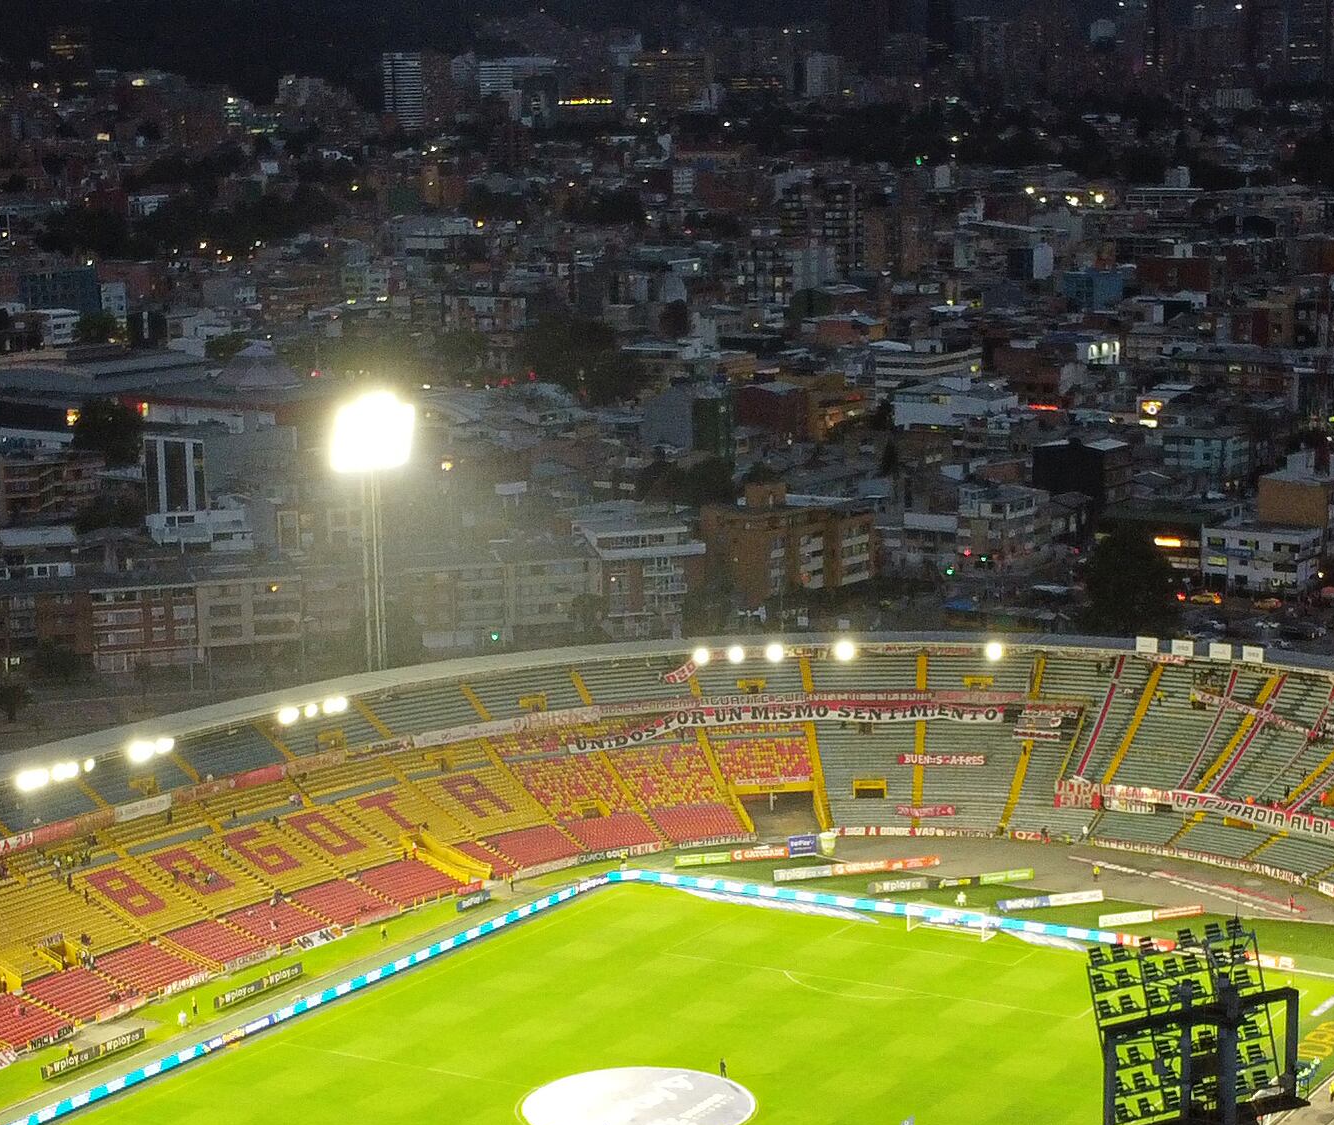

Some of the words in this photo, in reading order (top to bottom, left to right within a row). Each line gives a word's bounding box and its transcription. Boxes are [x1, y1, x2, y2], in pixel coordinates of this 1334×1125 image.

[575, 723, 657, 751] UNIDOS
[663, 710, 707, 730] POR
[715, 707, 743, 723] UN
[750, 704, 829, 722] MISMO
[838, 703, 999, 721] SENTIMIENTO
[1055, 779, 1102, 796] ULTRA
[1174, 793, 1199, 808] LA
[1203, 799, 1285, 825] GUARDIA
[915, 827, 936, 836] VAS
[16, 832, 33, 848] 25
[744, 849, 785, 859] GATORADE
